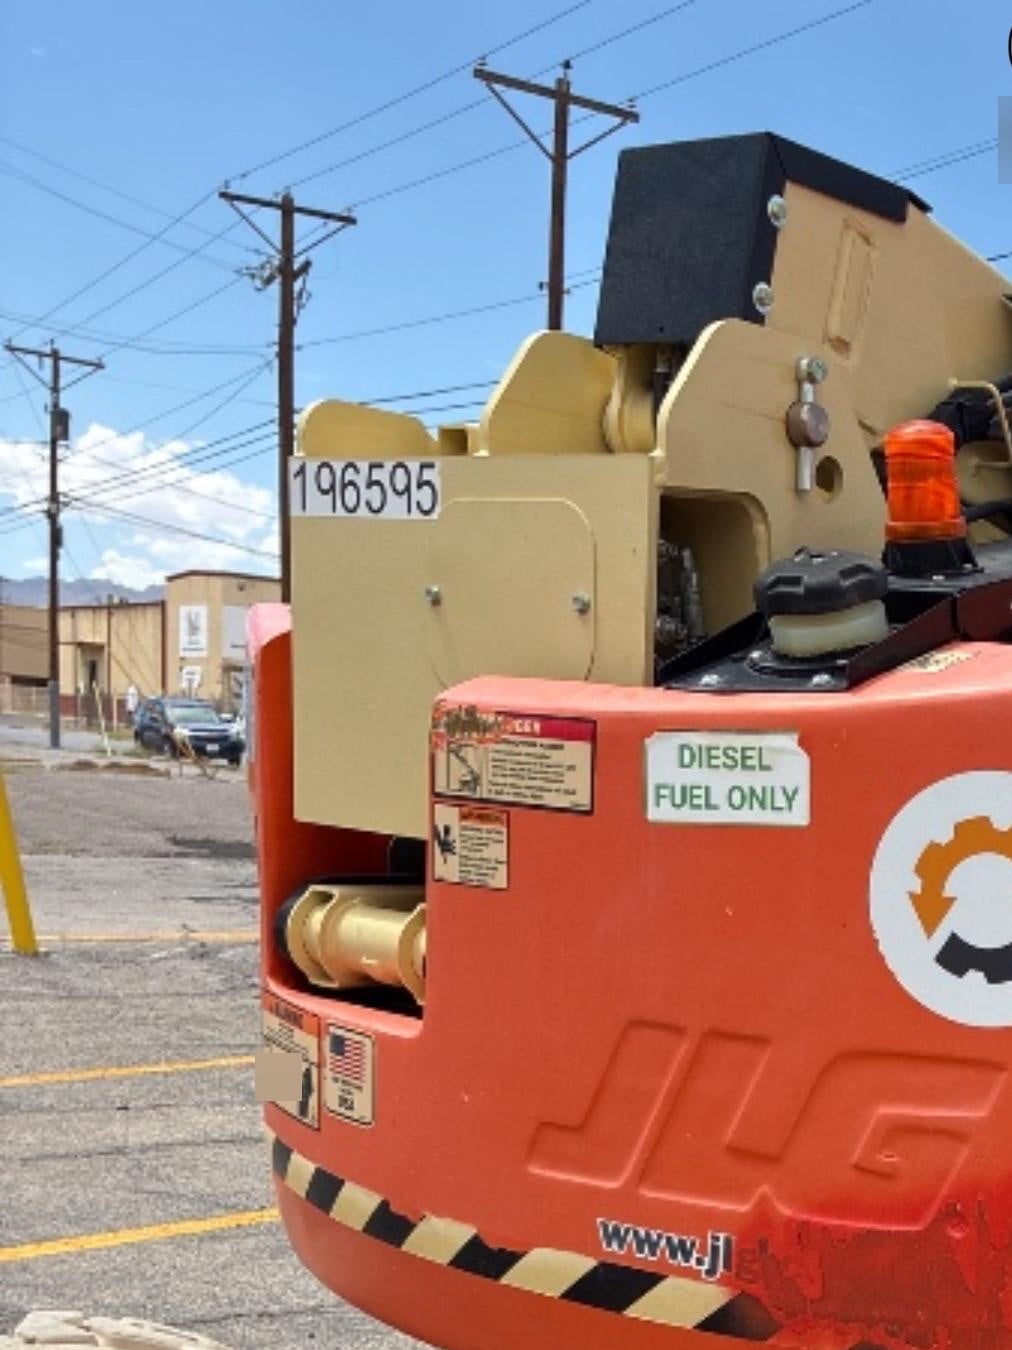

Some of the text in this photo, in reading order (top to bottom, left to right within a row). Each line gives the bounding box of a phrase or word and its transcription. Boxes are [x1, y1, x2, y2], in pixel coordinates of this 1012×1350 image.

[293, 461, 438, 516] 196595
[678, 743, 773, 771] DIESEL
[654, 783, 798, 812] FUEL ONLY
[526, 1019, 1008, 1231] JLG
